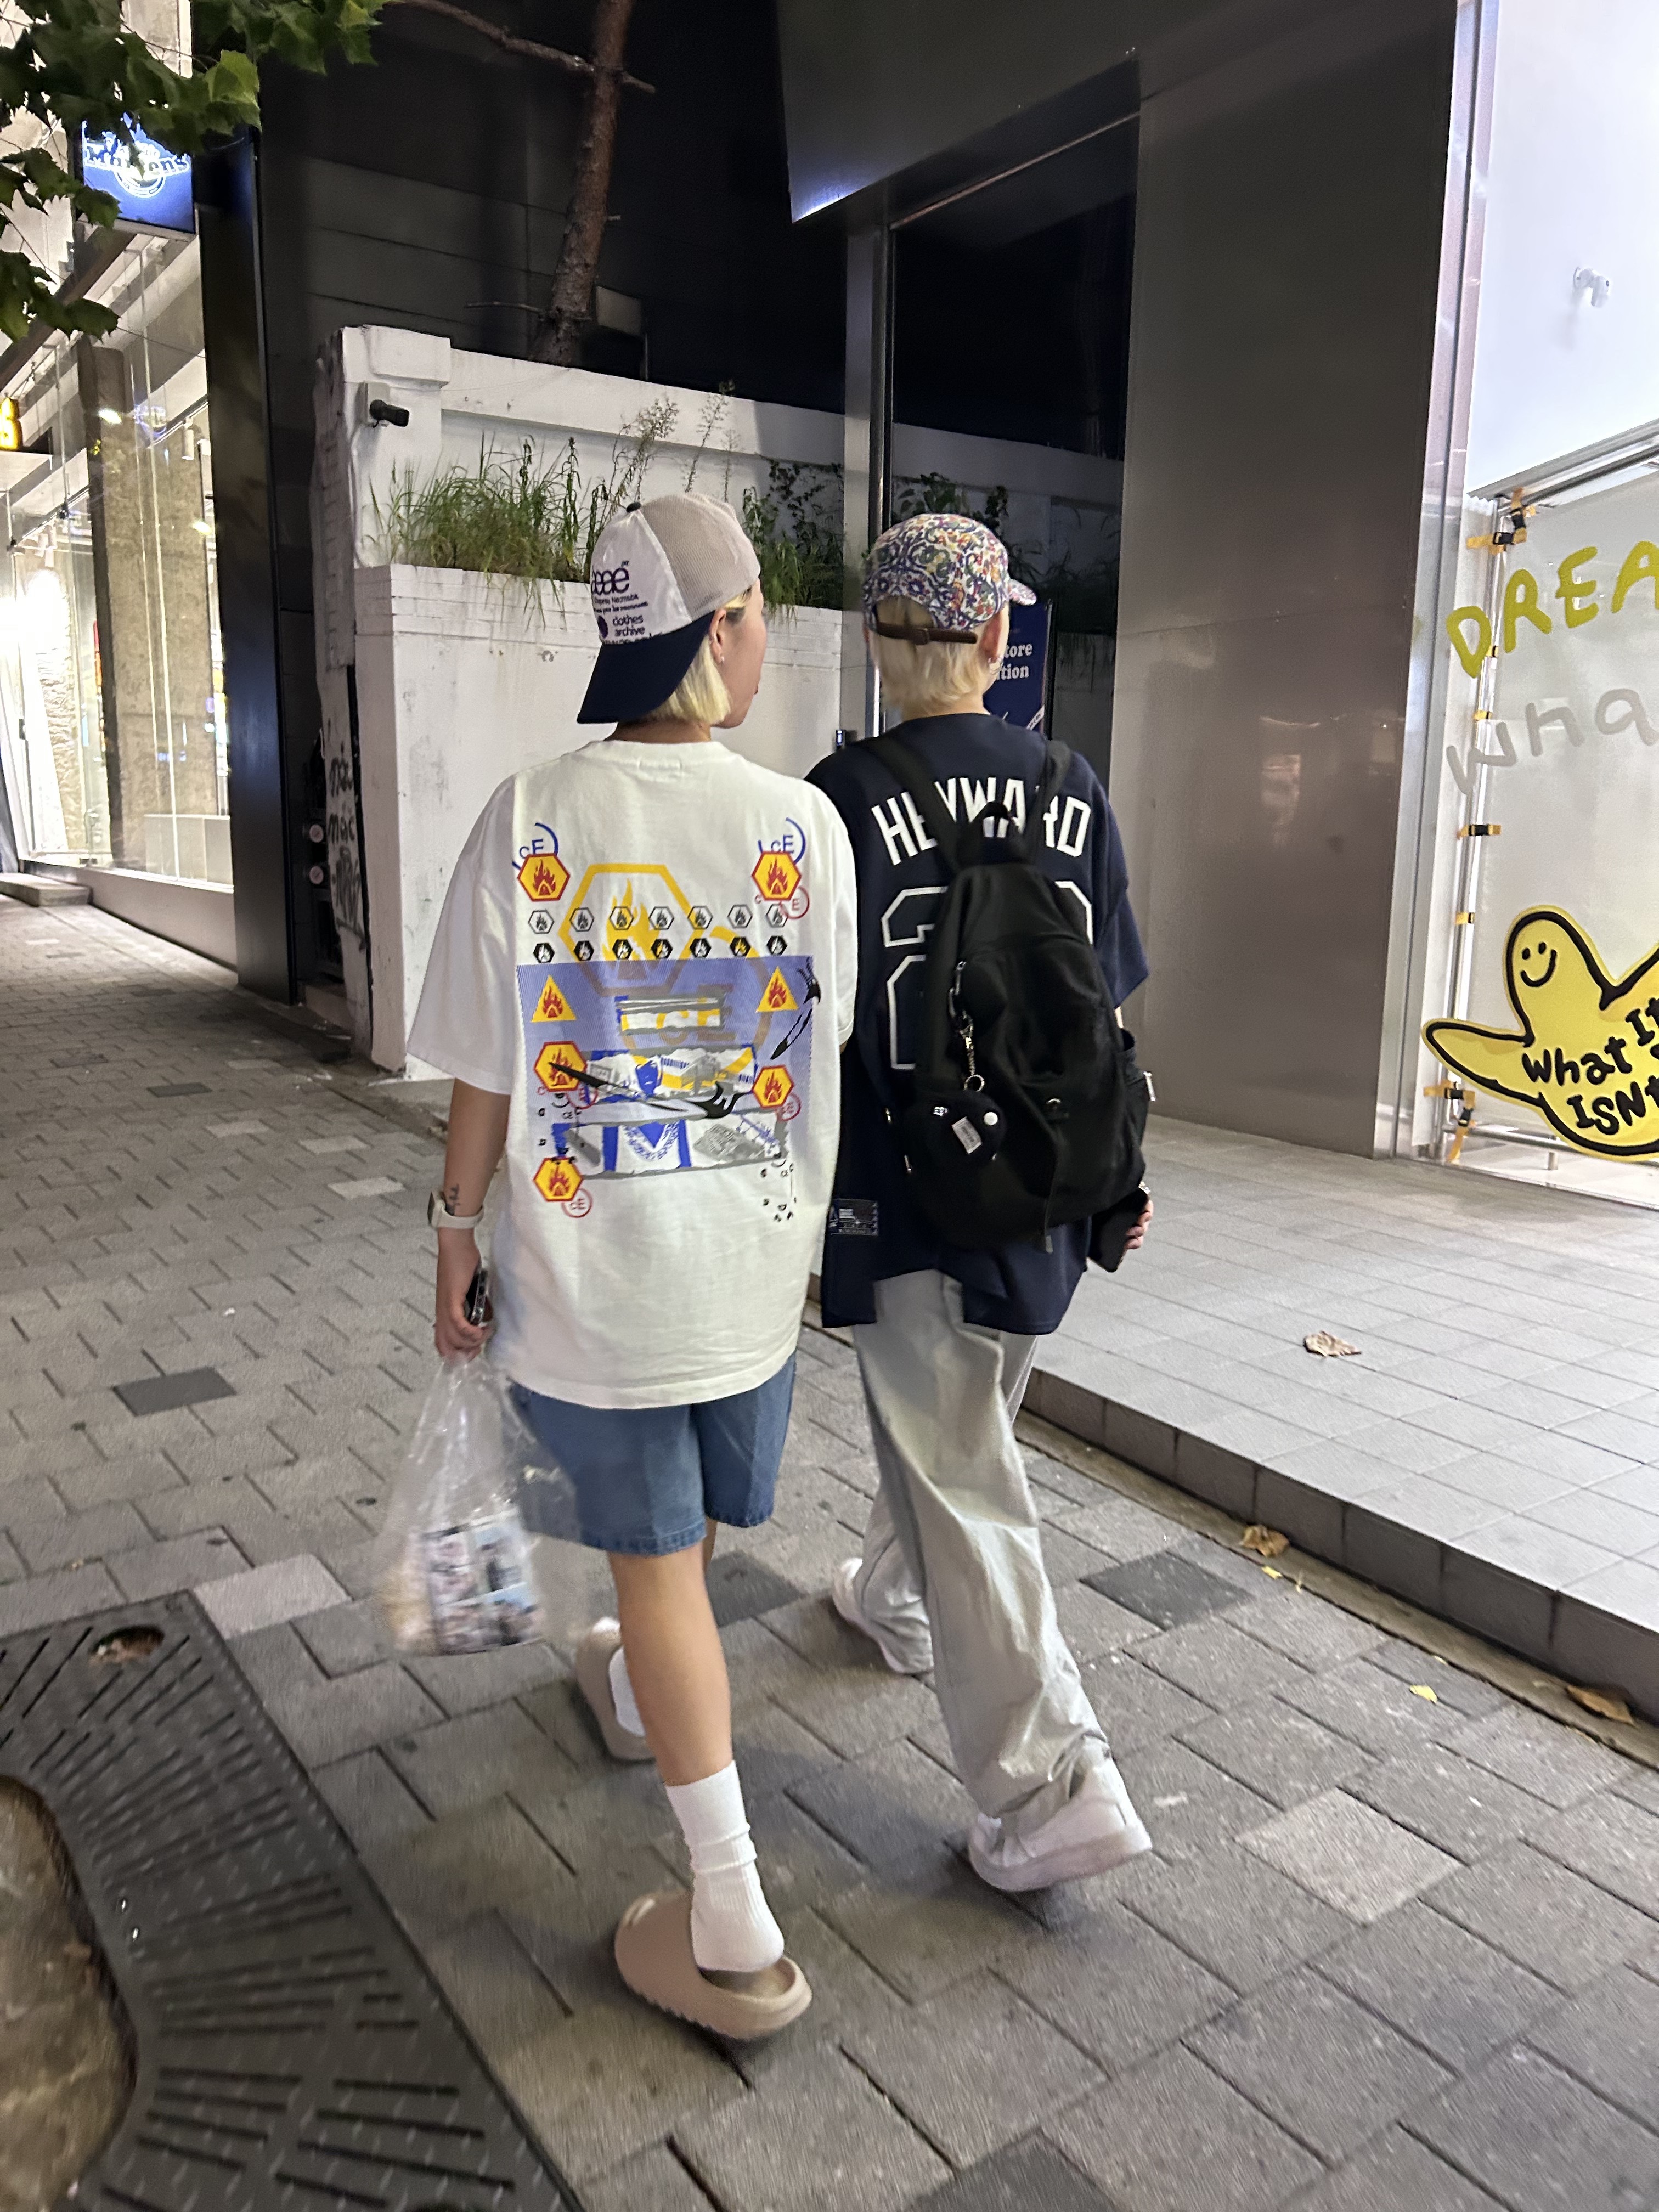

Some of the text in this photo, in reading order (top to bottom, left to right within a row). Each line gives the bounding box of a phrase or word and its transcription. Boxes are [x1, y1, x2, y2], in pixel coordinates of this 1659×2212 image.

[1003, 643, 1033, 659] tore
[996, 663, 1029, 681] tion
[1521, 1036, 1633, 1088] What
